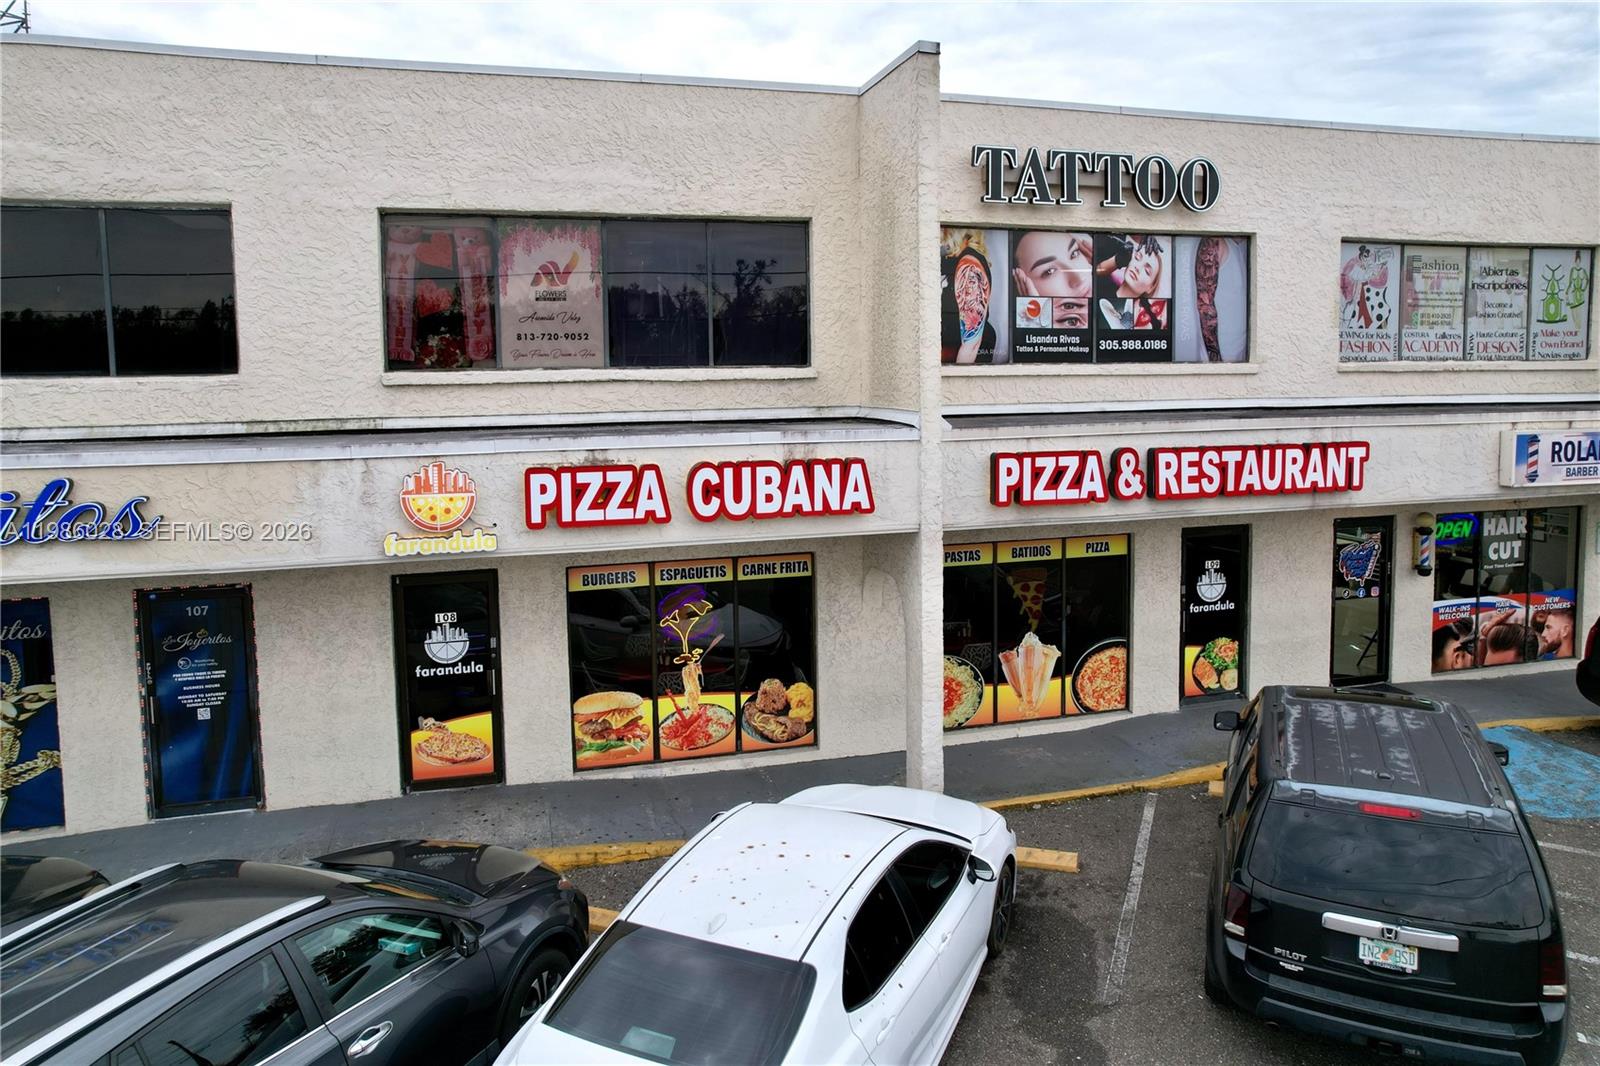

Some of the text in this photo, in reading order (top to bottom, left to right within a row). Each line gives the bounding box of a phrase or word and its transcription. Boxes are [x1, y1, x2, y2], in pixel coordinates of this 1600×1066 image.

[972, 144, 1221, 213] TATTOO
[535, 289, 567, 298] FLOWERS
[516, 333, 590, 341] 813-720-9052
[1025, 334, 1080, 344] Lisandra Rivas
[1099, 339, 1167, 350] 305.988.0186
[1339, 340, 1391, 353] FASHION
[1404, 340, 1460, 353] ACADEMY
[1476, 341, 1518, 353] DESIGN
[1551, 439, 1600, 463] ROLA
[993, 444, 1369, 504] PIZZA & RESTAURANT
[1565, 466, 1599, 477] BARBER
[527, 461, 874, 527] PIZZA CUBANA
[1435, 521, 1473, 539] OPEN
[1483, 516, 1528, 537] HAIR
[384, 529, 496, 555] farandula
[1086, 541, 1110, 553] PIZZA
[945, 549, 981, 563] PASTAS
[1011, 545, 1052, 559] BATIDOS
[1488, 540, 1522, 561] CUT
[660, 565, 727, 582] ESPAGUETIS
[742, 560, 809, 577] CARNE FRITA
[582, 570, 637, 587] BURGERS
[186, 605, 208, 617] 107
[1189, 600, 1235, 613] farandula
[1439, 604, 1471, 614] WALK-INS
[1533, 602, 1571, 612] CUSTOMERS
[437, 613, 456, 622] 108
[1439, 611, 1470, 620] WELCOME
[415, 661, 484, 677] farandula
[1273, 946, 1308, 962] PILOT
